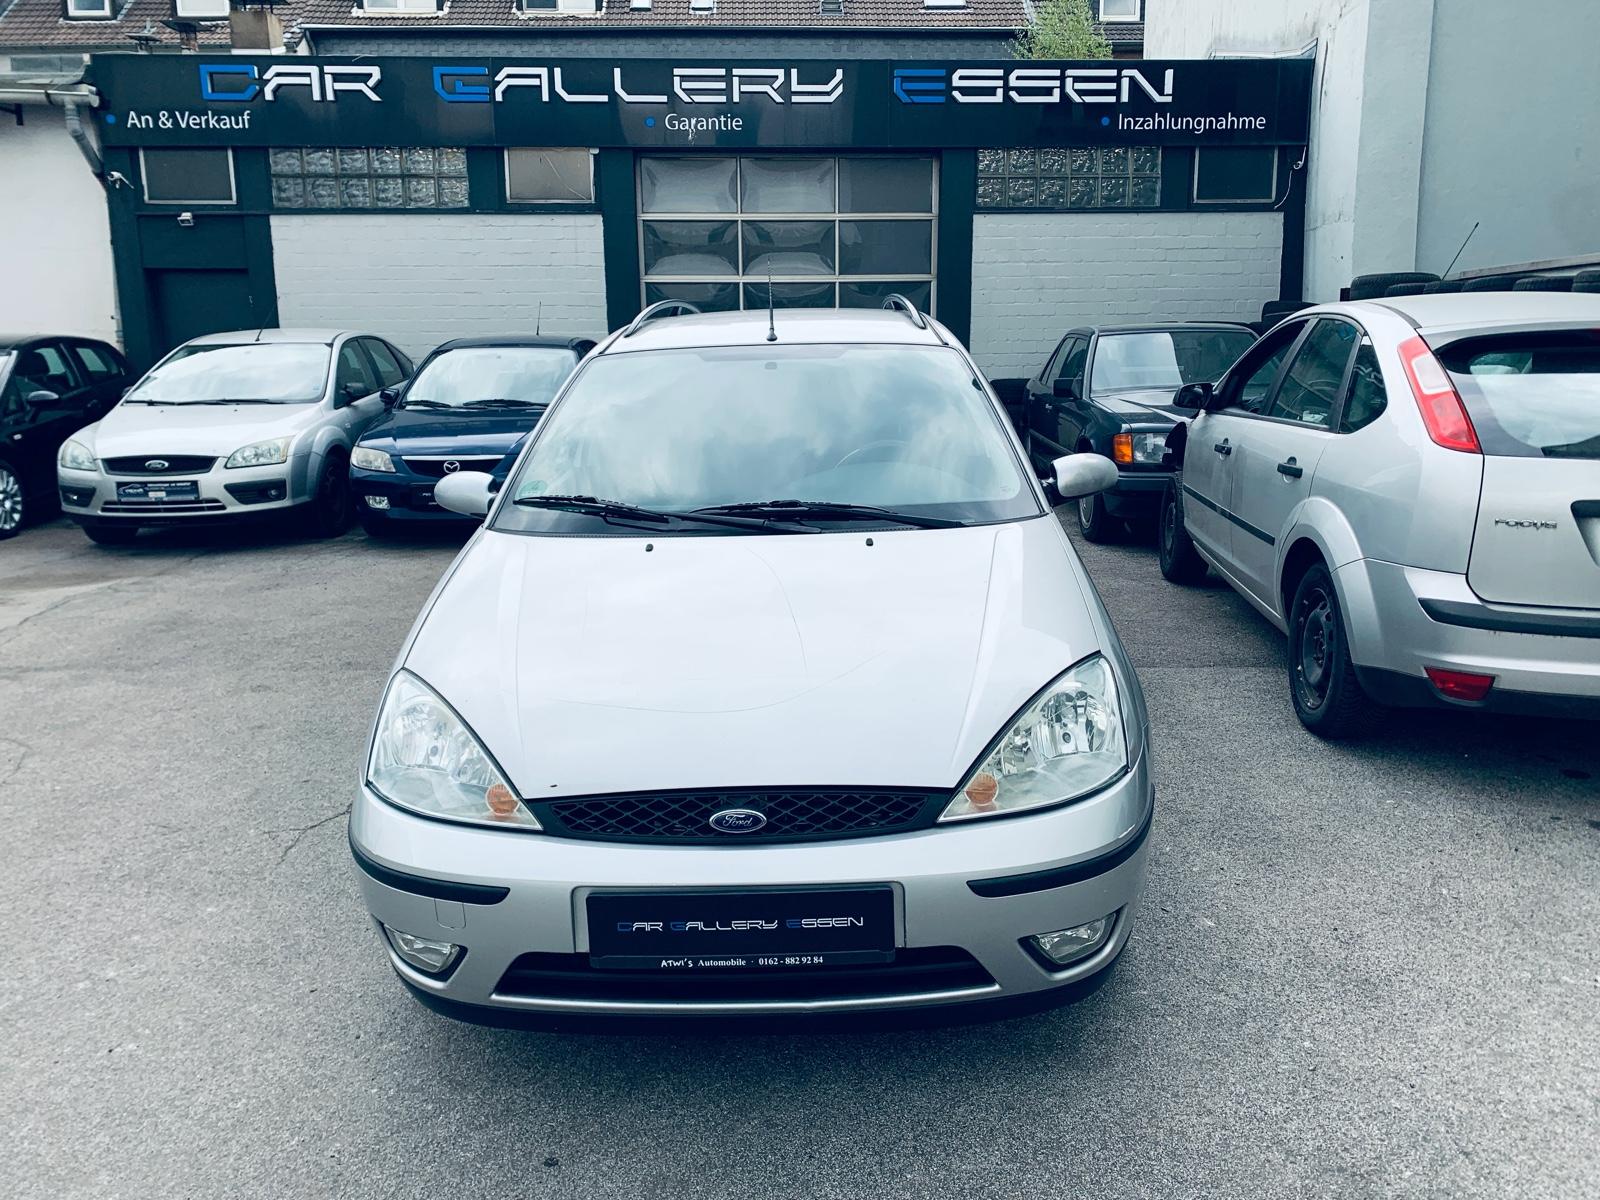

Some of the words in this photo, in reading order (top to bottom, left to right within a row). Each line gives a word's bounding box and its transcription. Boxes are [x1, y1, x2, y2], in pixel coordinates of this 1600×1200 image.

[200, 65, 381, 102] CAR
[434, 66, 844, 103] GALLERY
[893, 68, 1174, 104] ESSEN
[127, 111, 154, 128] An
[158, 111, 172, 129] &
[175, 110, 251, 129] Verkauf
[665, 113, 743, 132] Garantie
[1117, 113, 1267, 136] Inzahlungnahme
[722, 814, 753, 827] Ford
[617, 921, 664, 933] CAR
[670, 919, 779, 932] GALLERY
[786, 916, 864, 930] ESSEN
[697, 957, 747, 968] Automobile
[758, 957, 778, 966] 0162
[785, 956, 800, 965] 882
[801, 956, 811, 964] 92
[813, 955, 823, 964] 84
